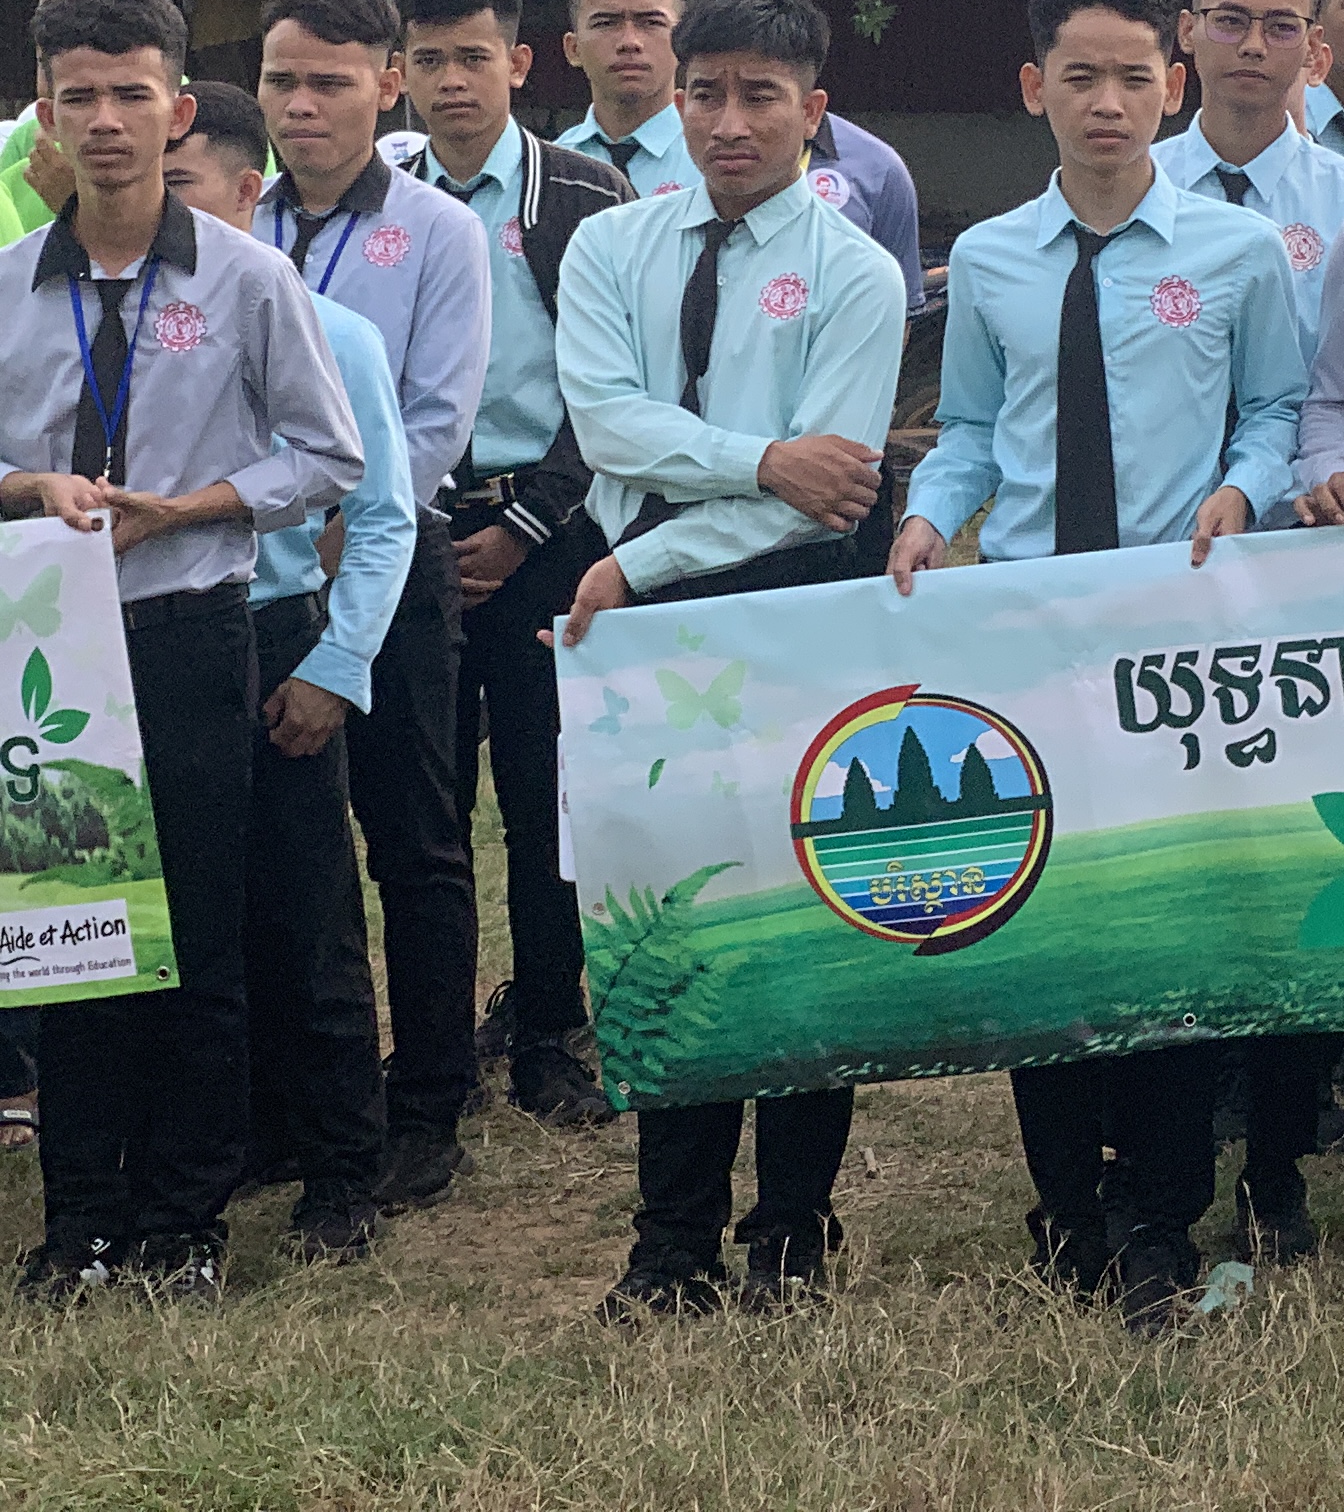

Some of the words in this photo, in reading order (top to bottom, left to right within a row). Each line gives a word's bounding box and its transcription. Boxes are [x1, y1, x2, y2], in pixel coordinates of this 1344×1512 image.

[0, 925, 36, 954] Aide
[39, 924, 58, 946] et
[60, 915, 127, 946] Action
[12, 967, 26, 979] the
[28, 965, 50, 978] world
[52, 961, 86, 975] through
[87, 957, 132, 971] Education
